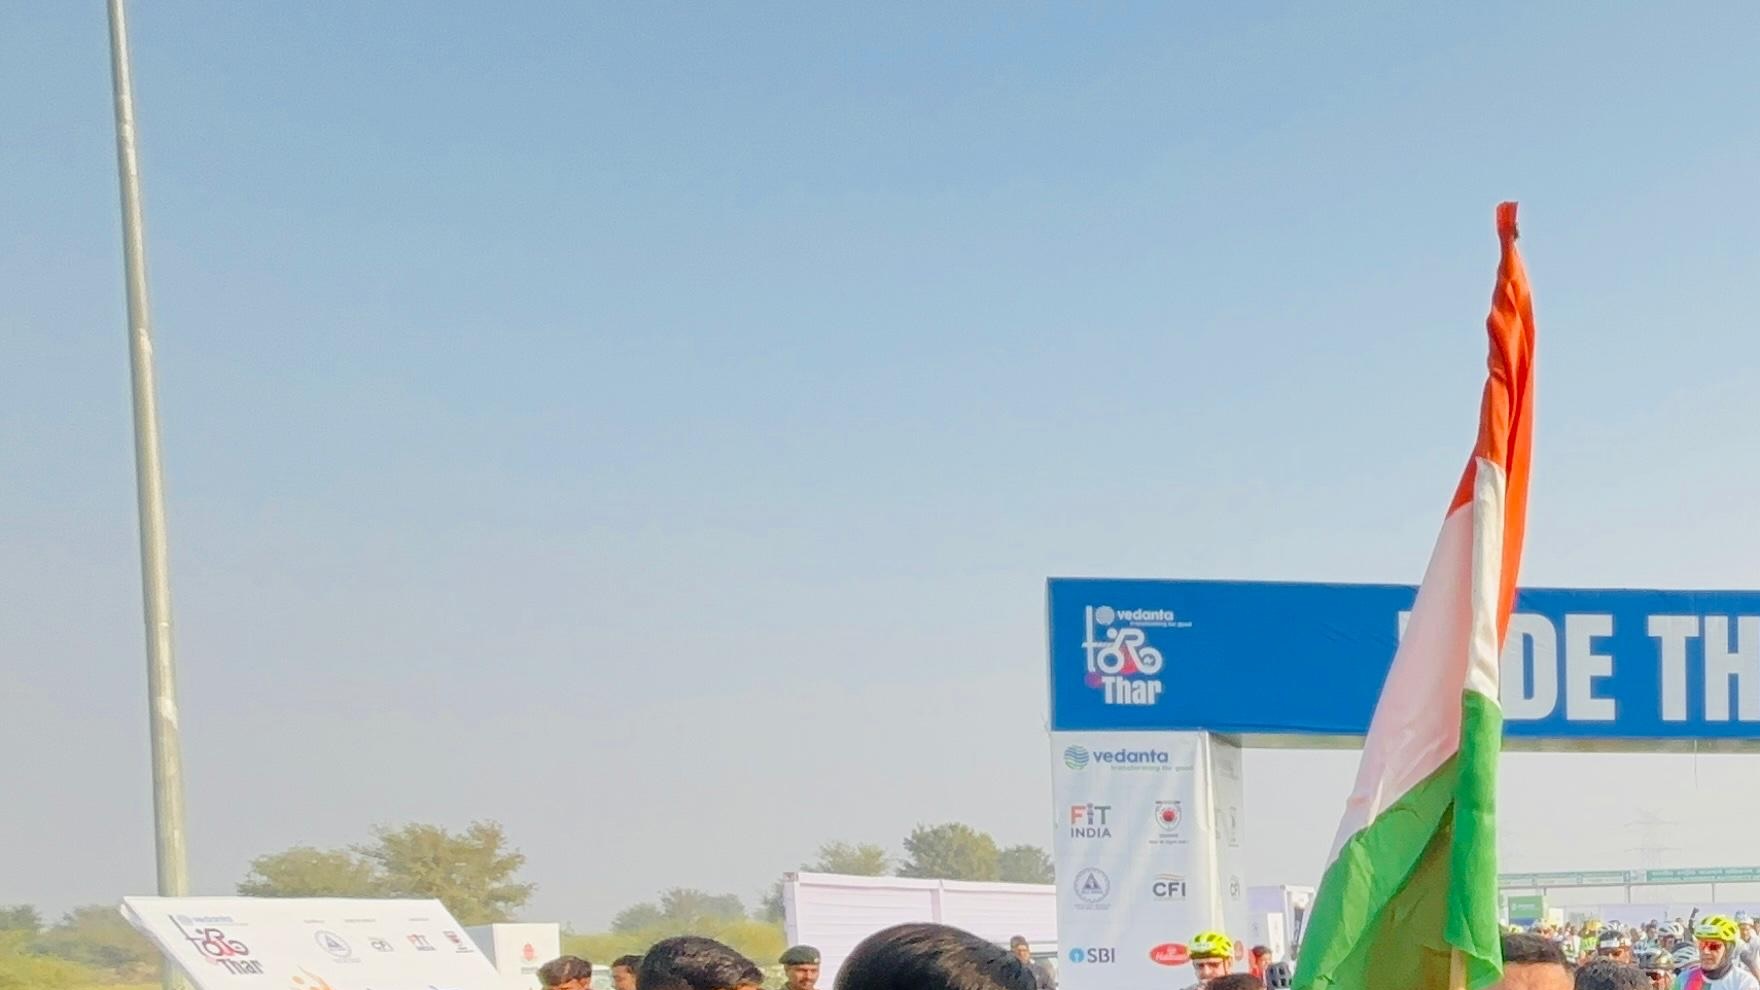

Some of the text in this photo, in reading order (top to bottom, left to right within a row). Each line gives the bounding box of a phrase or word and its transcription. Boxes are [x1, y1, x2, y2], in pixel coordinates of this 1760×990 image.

[1117, 609, 1174, 621] vedanta
[1101, 676, 1163, 705] Thar
[1092, 748, 1170, 763] vedanta
[1071, 827, 1112, 839] INDIA
[1152, 881, 1187, 898] CFI
[1087, 948, 1116, 964] SBI
[215, 958, 265, 975] Thar
